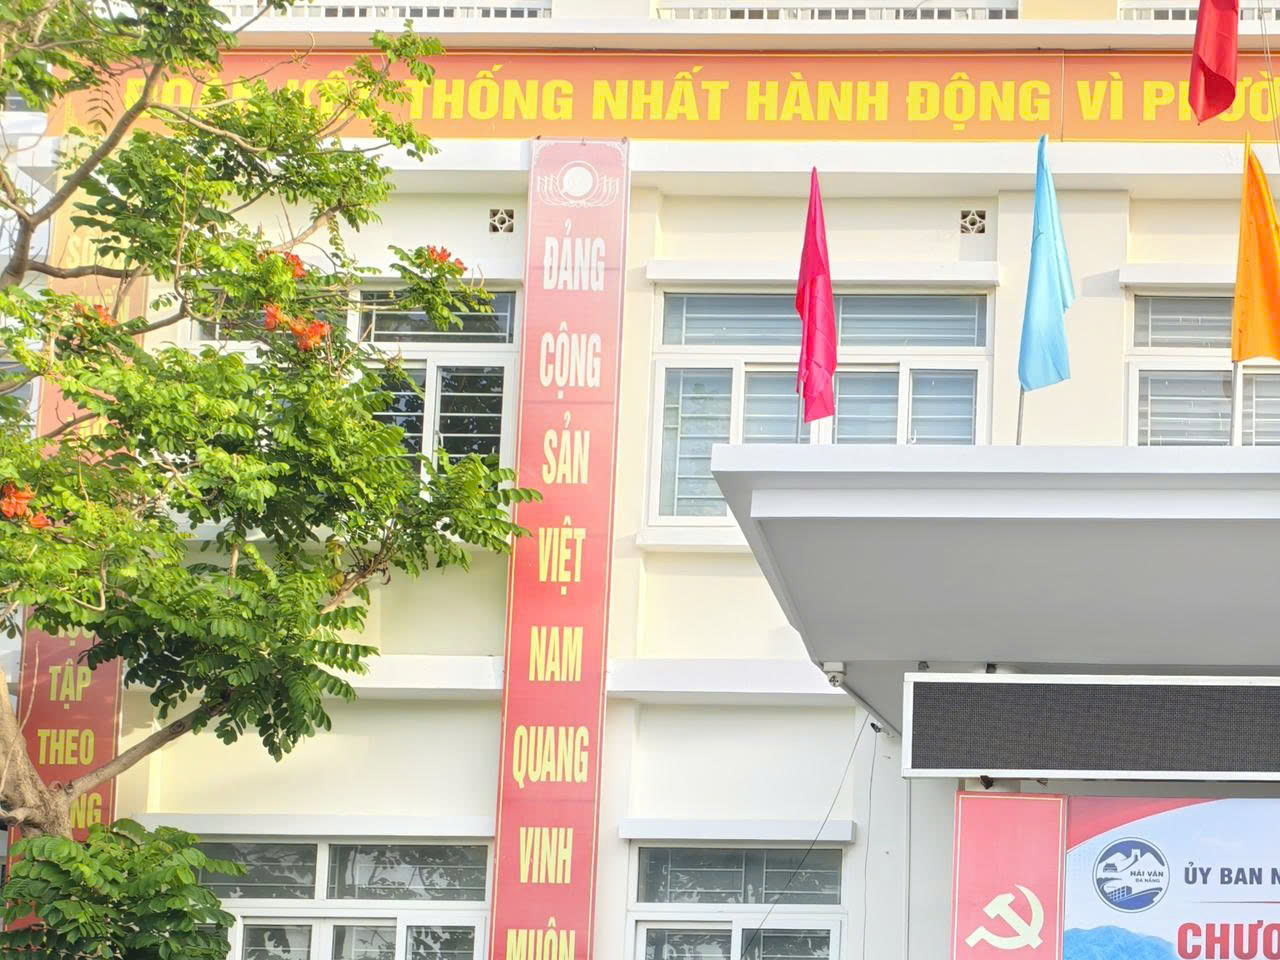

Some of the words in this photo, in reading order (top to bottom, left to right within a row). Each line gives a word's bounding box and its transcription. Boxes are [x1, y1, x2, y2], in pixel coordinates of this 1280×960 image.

[403, 64, 574, 121] THỐNG
[592, 66, 729, 121] NHẤT
[745, 71, 889, 121] HÀNH
[906, 72, 1051, 131] ĐỘNG
[1077, 72, 1123, 121] VÌ
[543, 218, 606, 292] ĐẢNG
[538, 321, 602, 400] CỘNG
[541, 410, 591, 485] SẢN
[538, 515, 586, 596] VIỆT
[49, 658, 92, 710] TẬP
[528, 625, 584, 682] NAM
[37, 729, 96, 766] THEO
[512, 725, 590, 789] QUANG
[519, 826, 574, 884] VINH
[1184, 861, 1212, 885] ỦY
[1220, 868, 1263, 885] BAN
